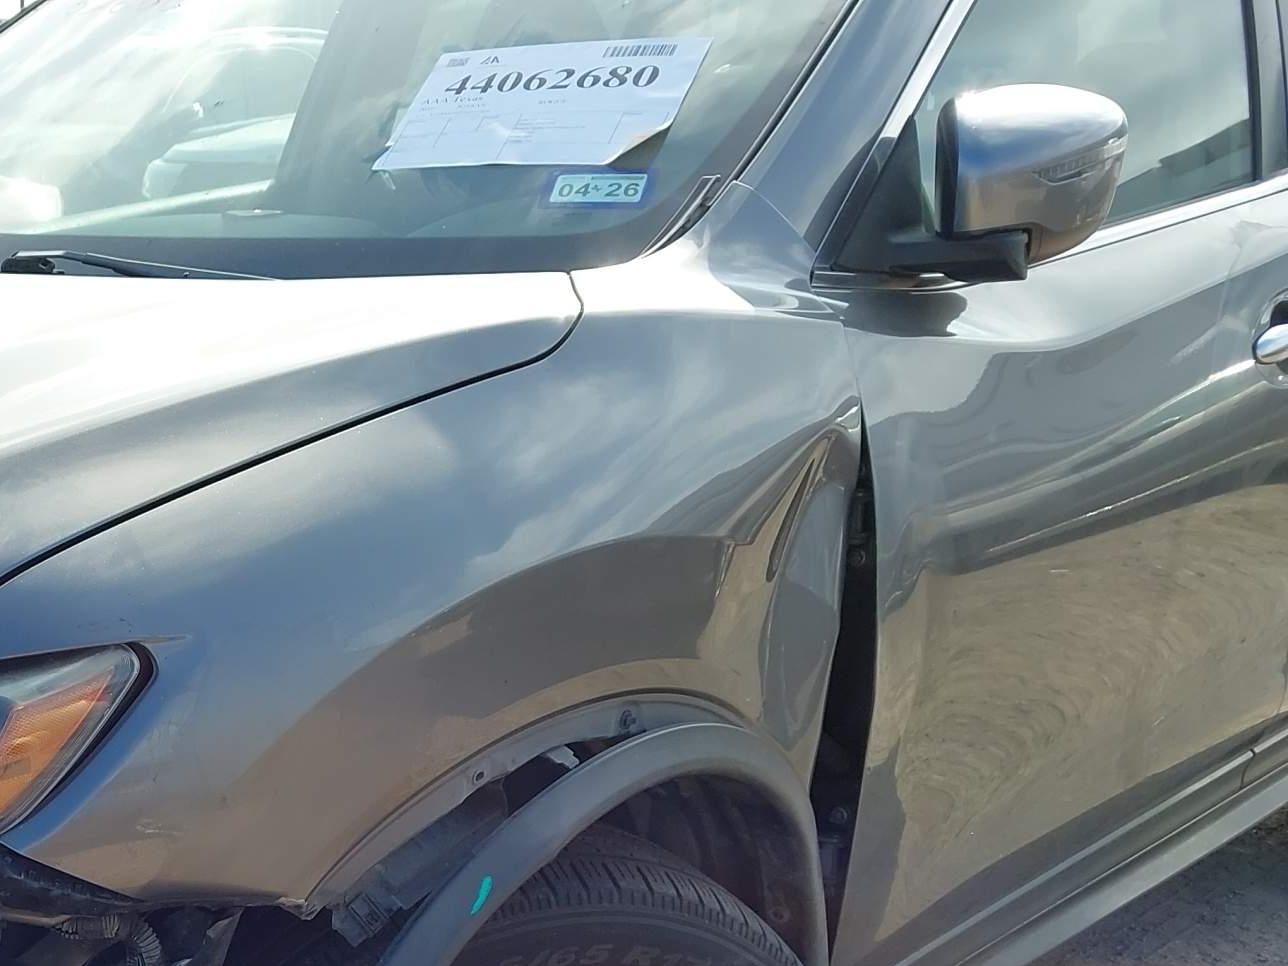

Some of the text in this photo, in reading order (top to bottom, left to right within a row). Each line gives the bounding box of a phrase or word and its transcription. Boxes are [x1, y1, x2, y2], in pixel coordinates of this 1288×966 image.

[444, 63, 661, 95] 44062680
[558, 182, 641, 198] 04 26
